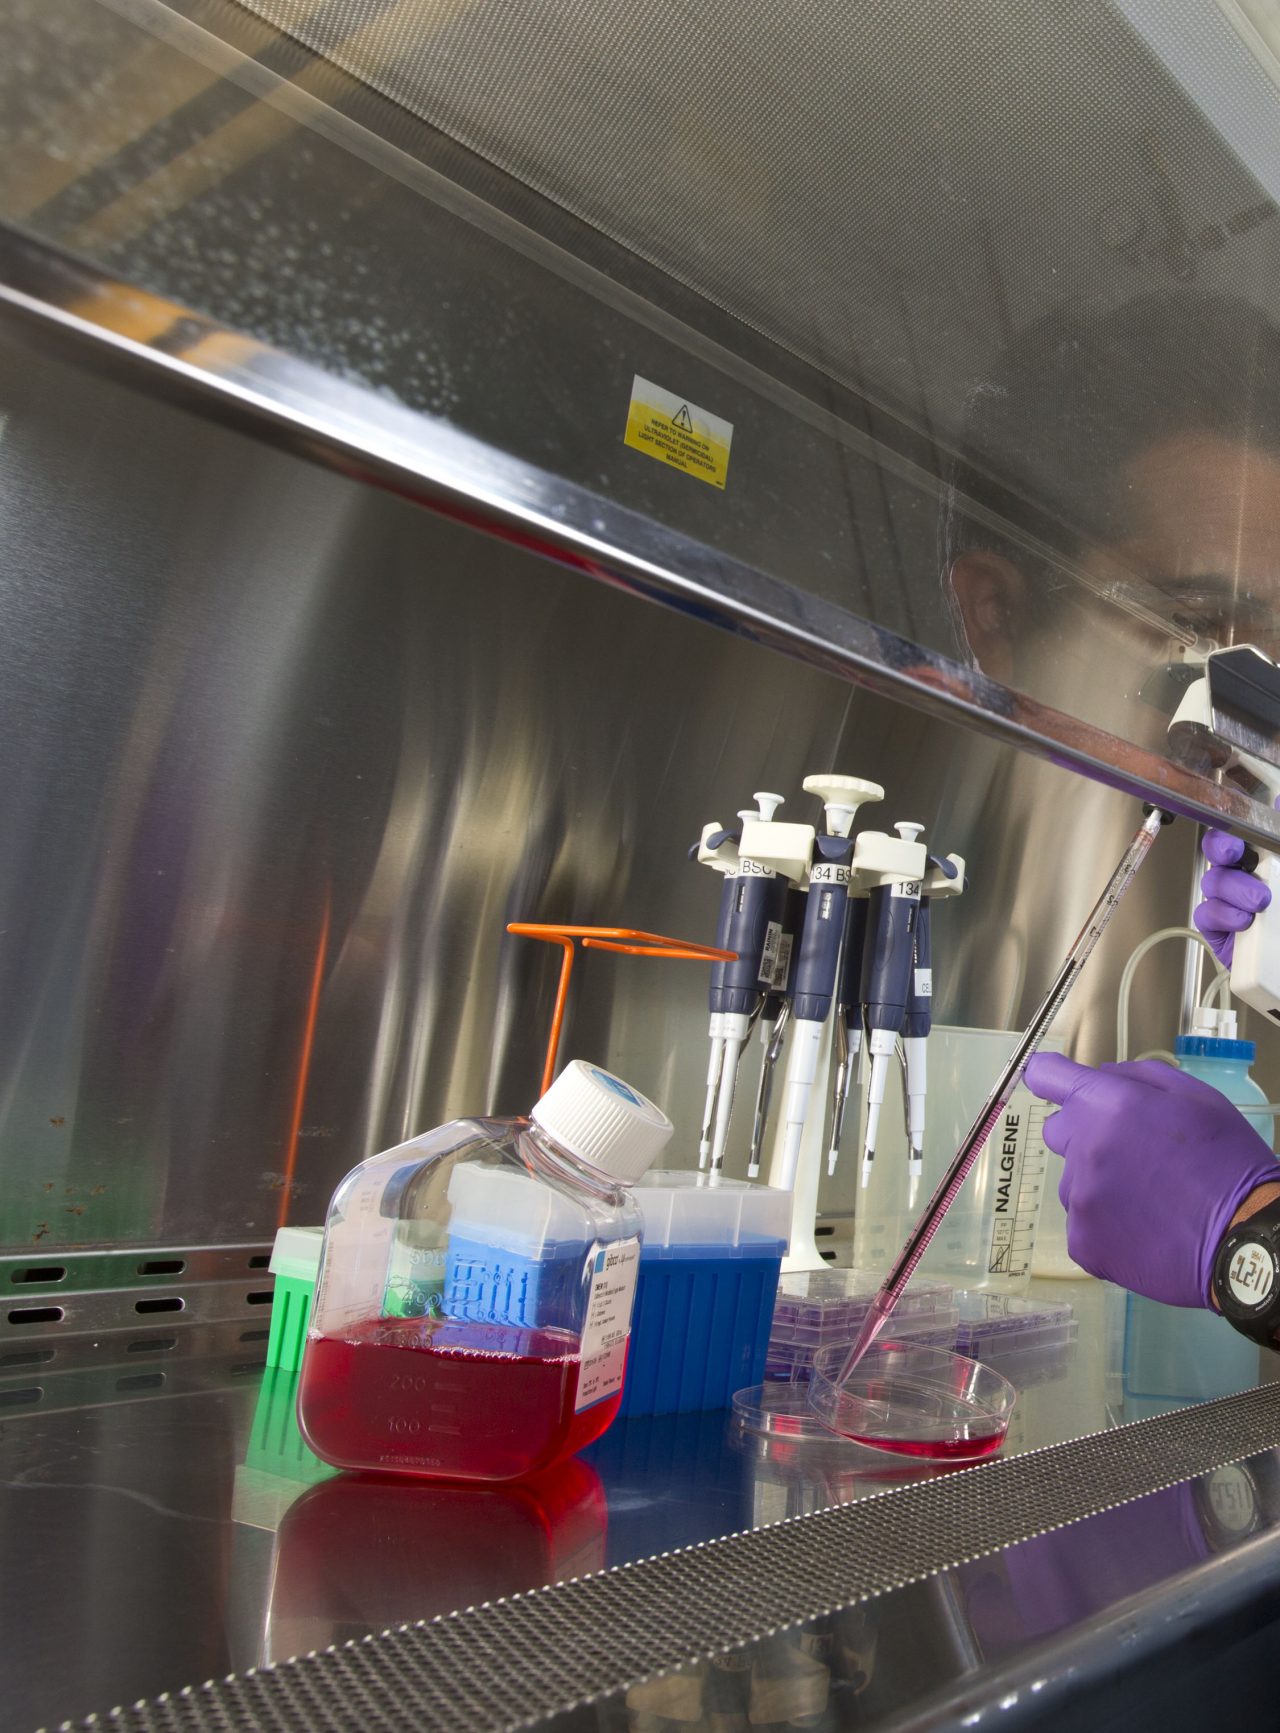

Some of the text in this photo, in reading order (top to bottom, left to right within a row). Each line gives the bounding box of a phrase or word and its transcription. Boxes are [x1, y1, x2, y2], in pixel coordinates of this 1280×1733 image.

[644, 424, 679, 444] ULTRAVIOLET
[652, 419, 710, 451] REFER TO WARNING ON
[638, 432, 716, 472] LIGHT SECTION OF OPERATORS
[666, 454, 687, 468] MANUAL
[899, 882, 919, 896] 134
[995, 1114, 1020, 1212] NALGENE
[390, 1374, 426, 1391] 200
[388, 1417, 420, 1433] 100
